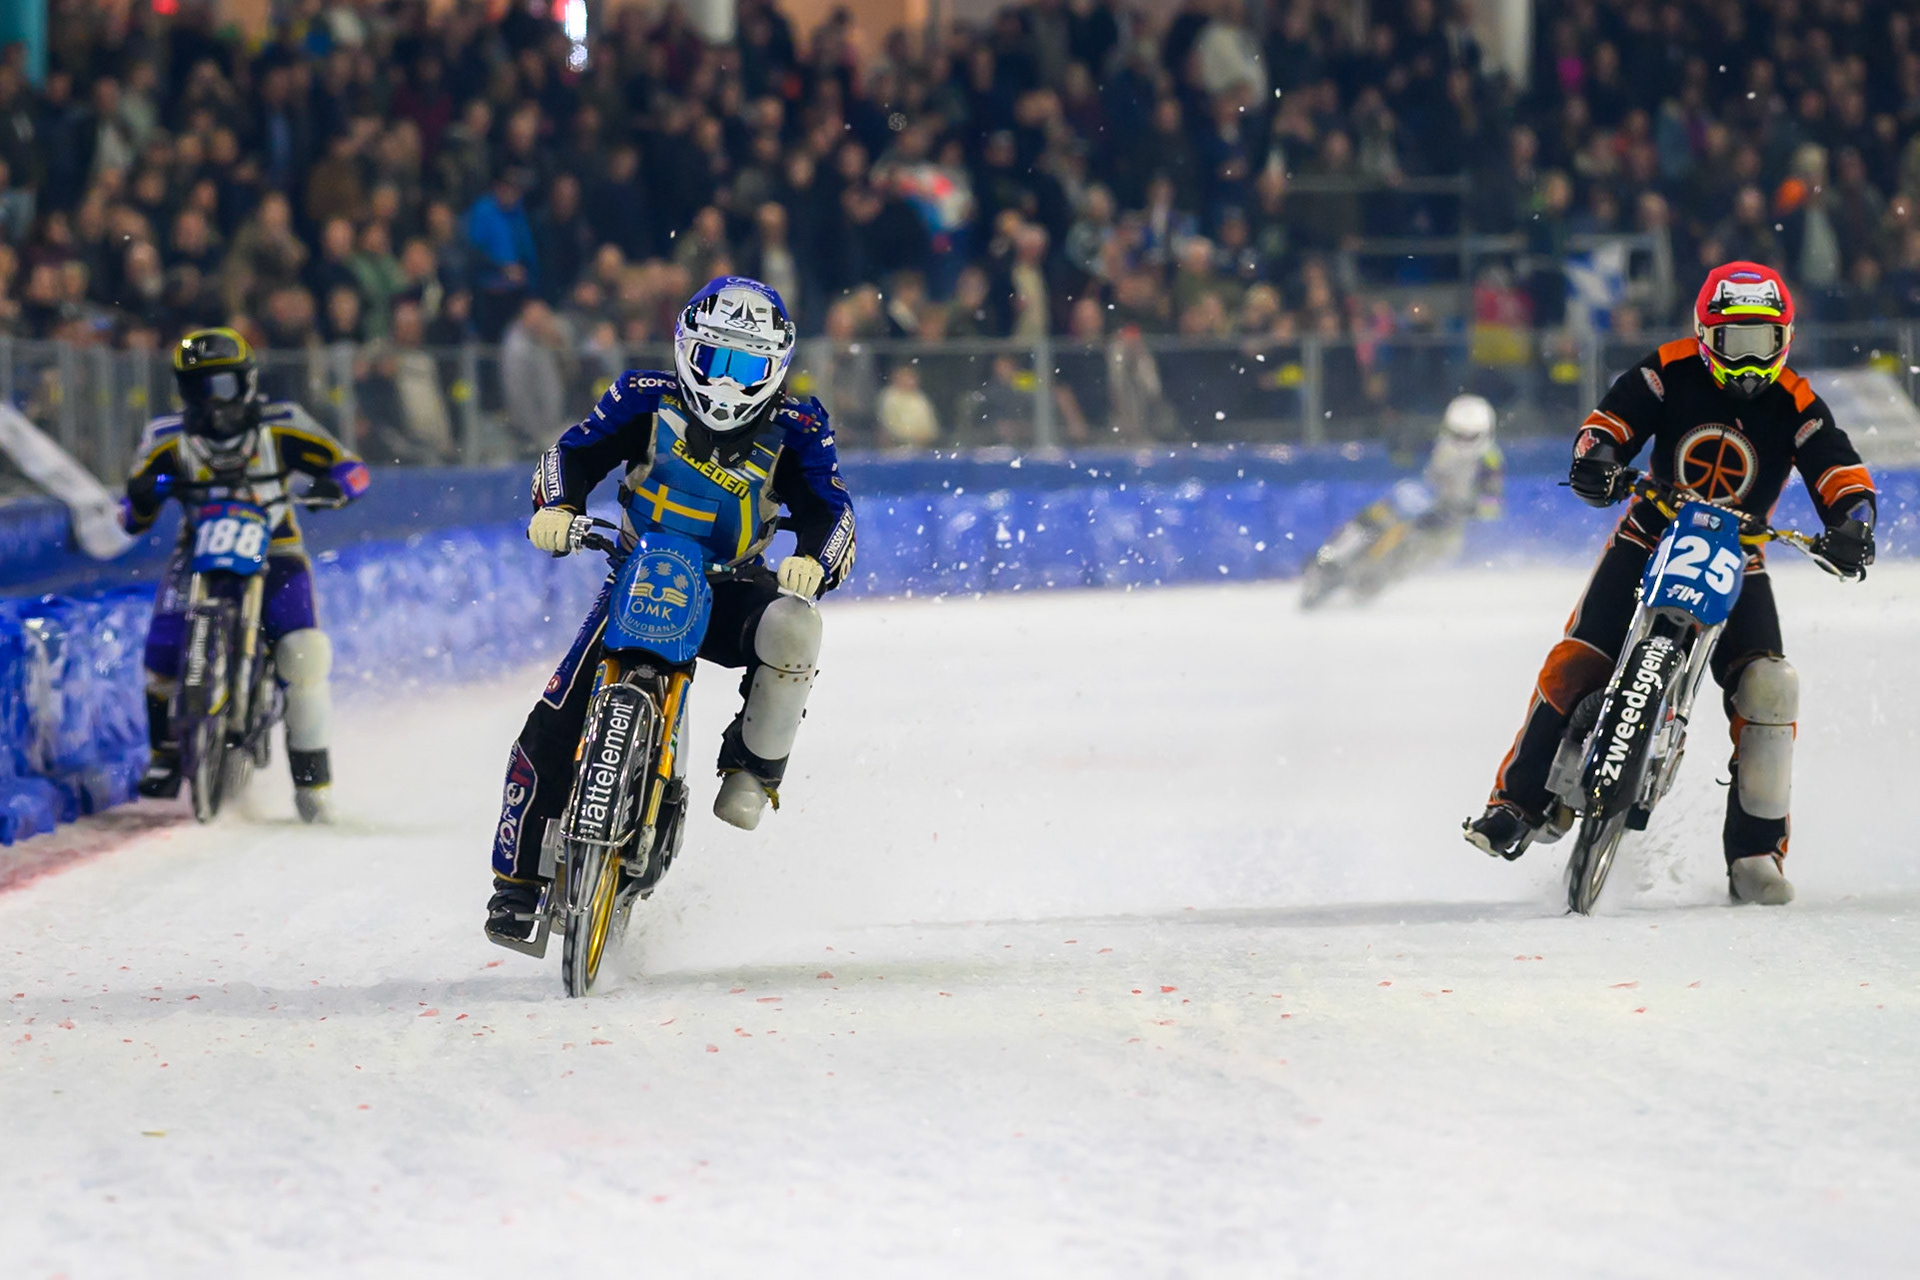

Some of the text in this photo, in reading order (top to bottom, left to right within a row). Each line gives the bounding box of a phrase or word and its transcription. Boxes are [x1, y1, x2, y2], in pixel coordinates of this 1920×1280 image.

[637, 378, 677, 389] core
[194, 518, 263, 559] 188
[1649, 535, 1741, 595] 125
[1666, 584, 1704, 605] FIM
[631, 598, 673, 620] ÖMK
